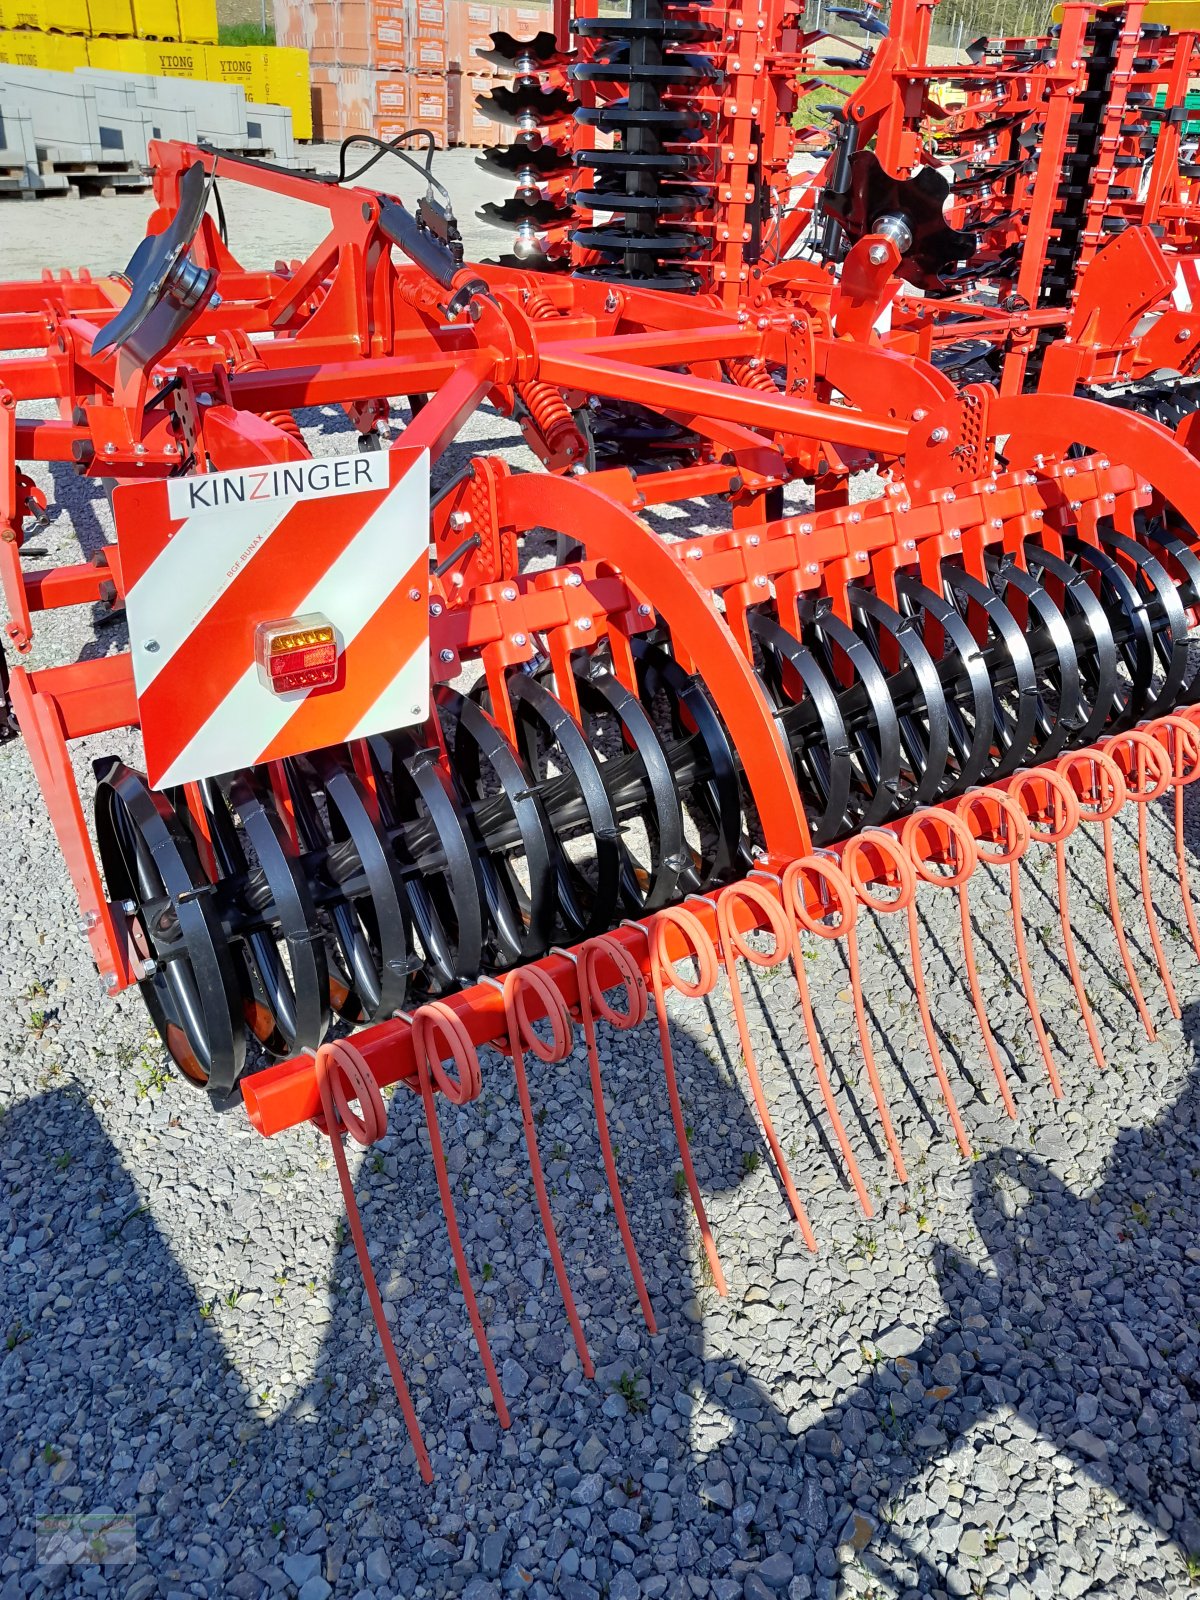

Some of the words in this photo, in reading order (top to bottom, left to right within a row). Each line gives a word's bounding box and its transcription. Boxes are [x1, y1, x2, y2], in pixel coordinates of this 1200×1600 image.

[159, 55, 193, 68] YTONG
[219, 60, 252, 72] YTONG
[189, 459, 373, 509] KINZINGER
[226, 533, 264, 578] BGF-BUNAX
